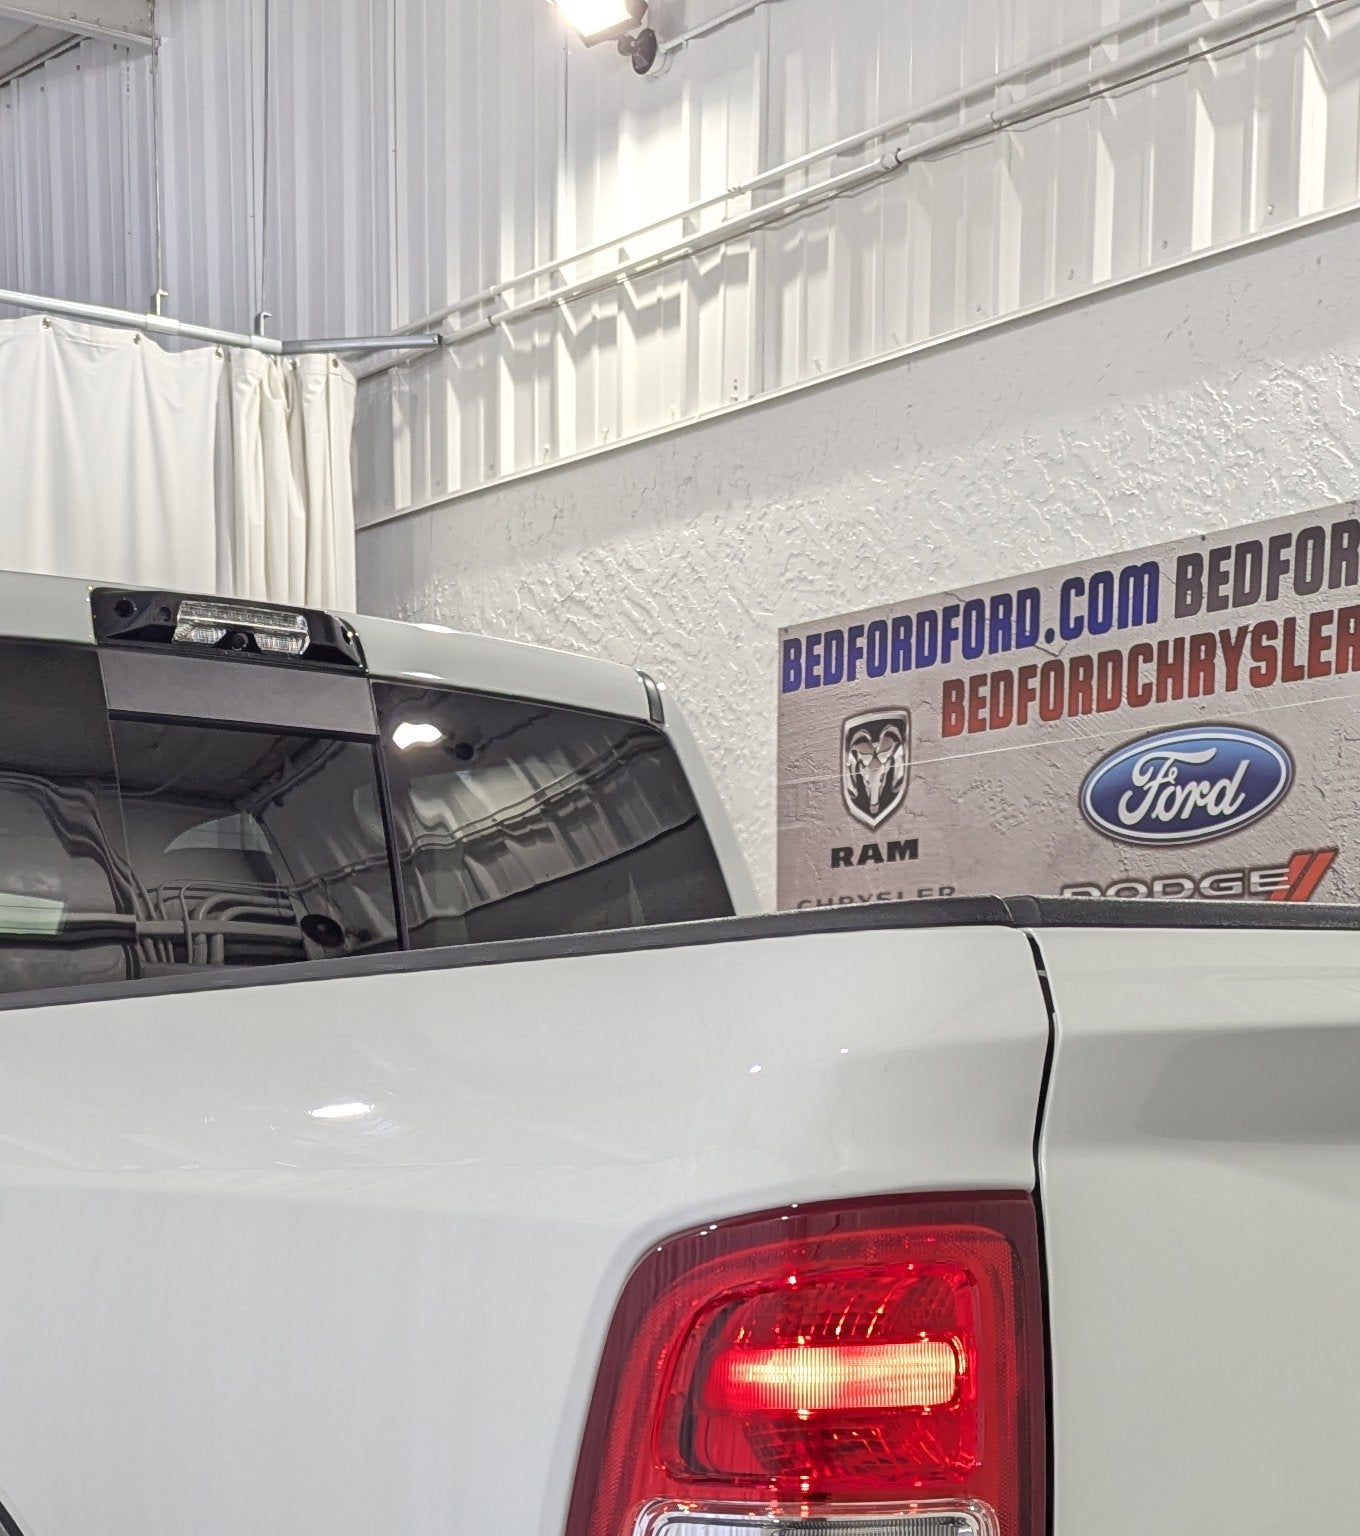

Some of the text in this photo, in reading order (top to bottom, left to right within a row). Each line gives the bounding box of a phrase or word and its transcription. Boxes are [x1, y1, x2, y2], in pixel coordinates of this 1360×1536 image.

[782, 561, 1160, 694] BEDFORDFORD.COM
[1118, 747, 1251, 826] Ford
[830, 838, 920, 869] RAM
